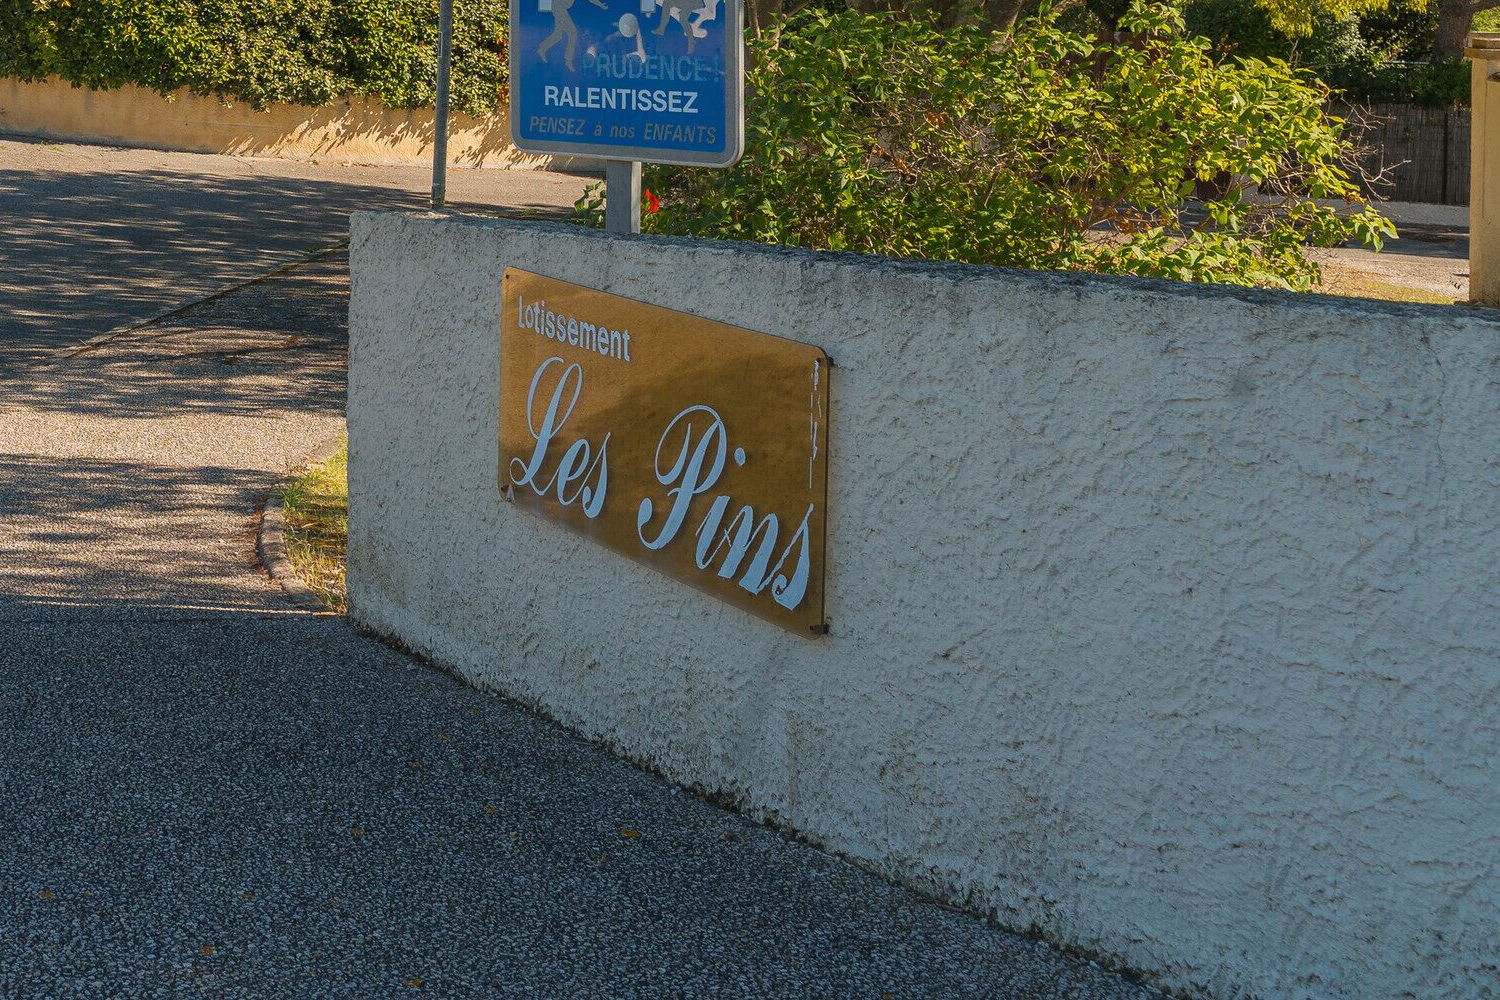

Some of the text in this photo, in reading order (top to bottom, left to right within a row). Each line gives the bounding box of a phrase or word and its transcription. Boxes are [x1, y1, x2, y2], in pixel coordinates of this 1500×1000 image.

[545, 85, 699, 114] RALENTISSEZ
[529, 116, 586, 136] PENSEZ
[610, 125, 636, 139] nos
[643, 123, 717, 145] ENFANTS
[518, 295, 632, 362] Lotissement
[509, 356, 814, 611] Les Pins
